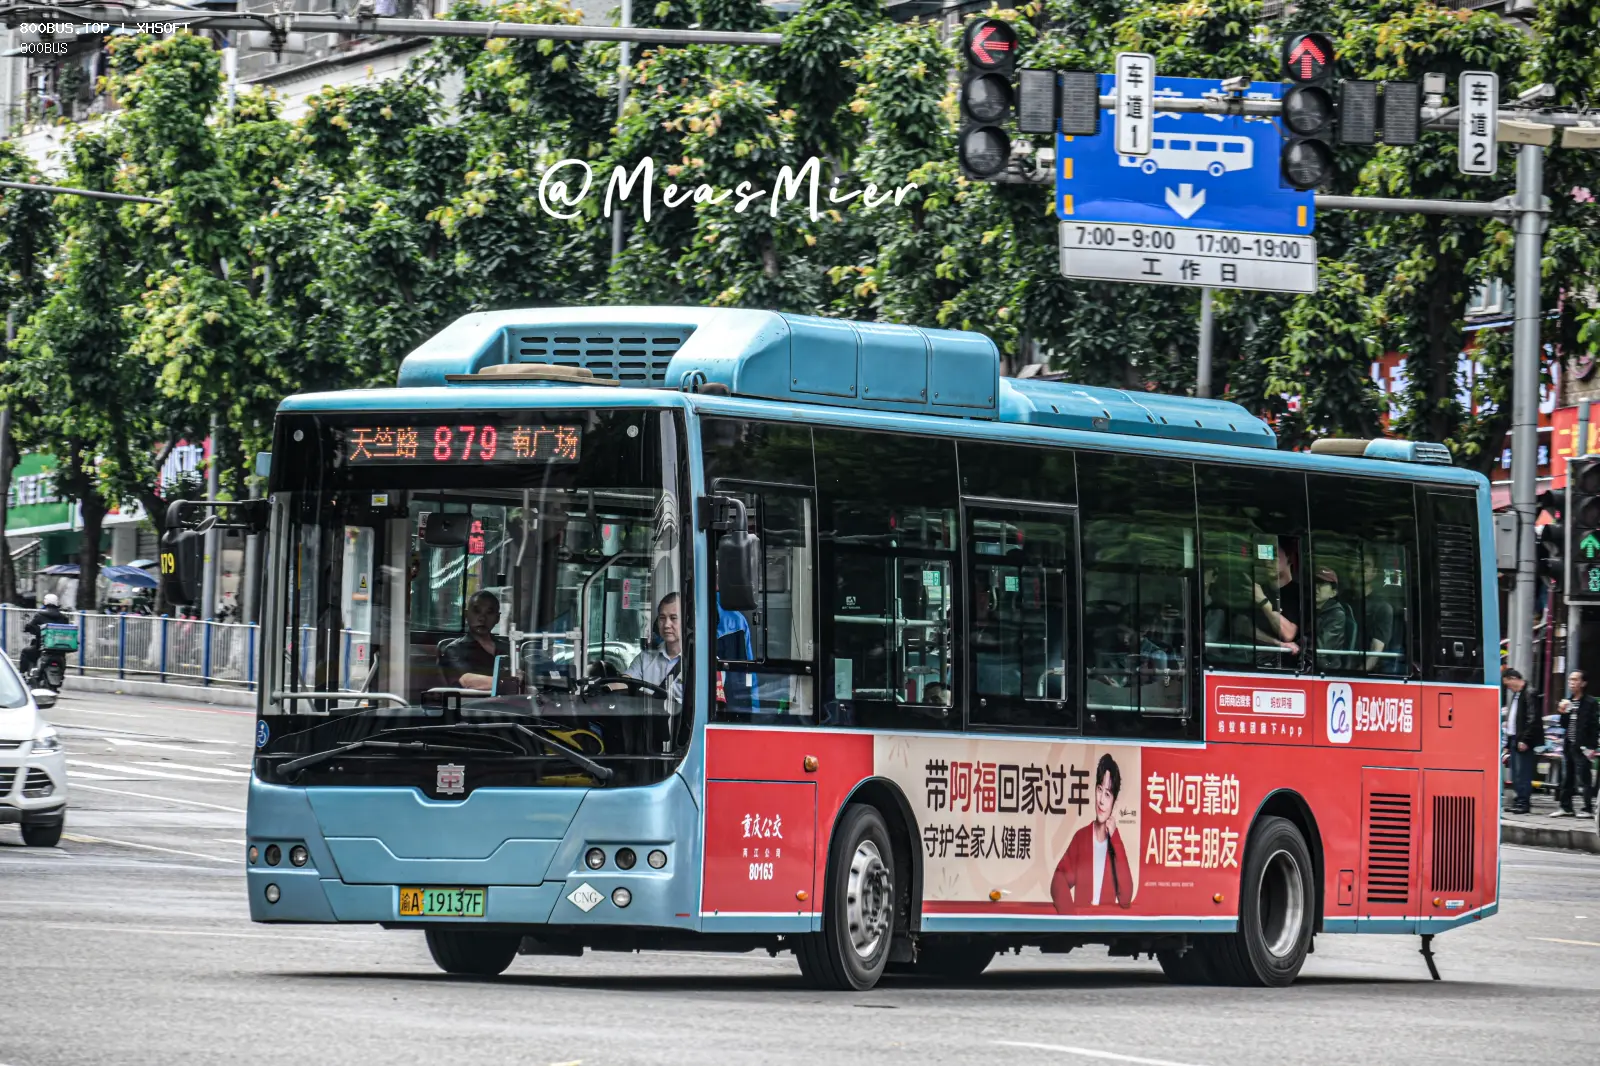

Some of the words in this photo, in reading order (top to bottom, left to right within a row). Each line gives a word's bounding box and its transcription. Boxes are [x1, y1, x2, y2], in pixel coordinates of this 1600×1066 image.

[1470, 81, 1489, 166] 车道2
[1141, 257, 1238, 284] 工作日
[350, 426, 419, 460] 天竺路
[432, 425, 498, 460] 879
[1355, 695, 1414, 733] 蚂蚁阿福
[925, 758, 1090, 817] 带阿福回家过年
[1146, 771, 1240, 816] 专业可靠的
[741, 813, 783, 839] 重庆公交
[923, 823, 1032, 860] 守护全家人健康
[1145, 825, 1239, 869] AI医生朋友
[749, 862, 773, 881] 80163
[572, 890, 599, 904] CNG
